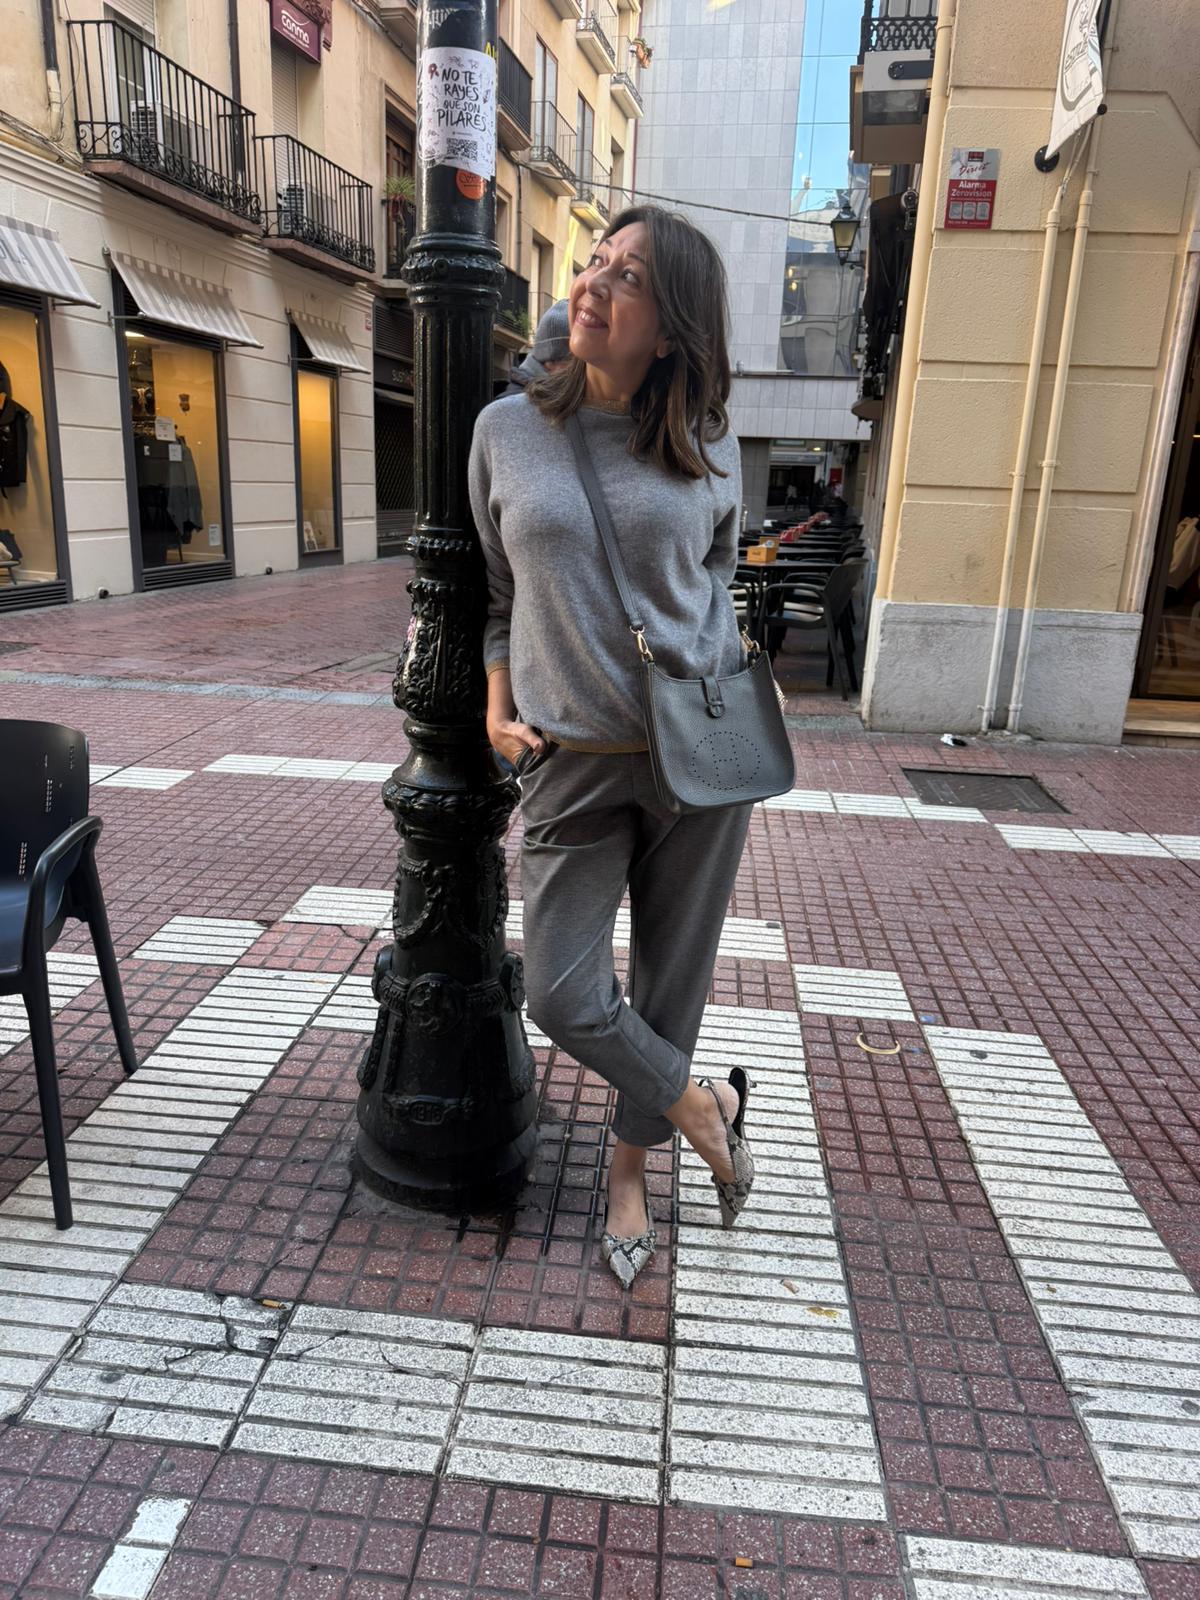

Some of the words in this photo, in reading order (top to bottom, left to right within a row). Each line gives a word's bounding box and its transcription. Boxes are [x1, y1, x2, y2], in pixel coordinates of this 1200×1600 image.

[441, 67, 460, 82] NO
[462, 71, 478, 85] TE
[444, 83, 479, 101] RAYES
[462, 102, 481, 114] SON
[436, 109, 487, 131] PILARES
